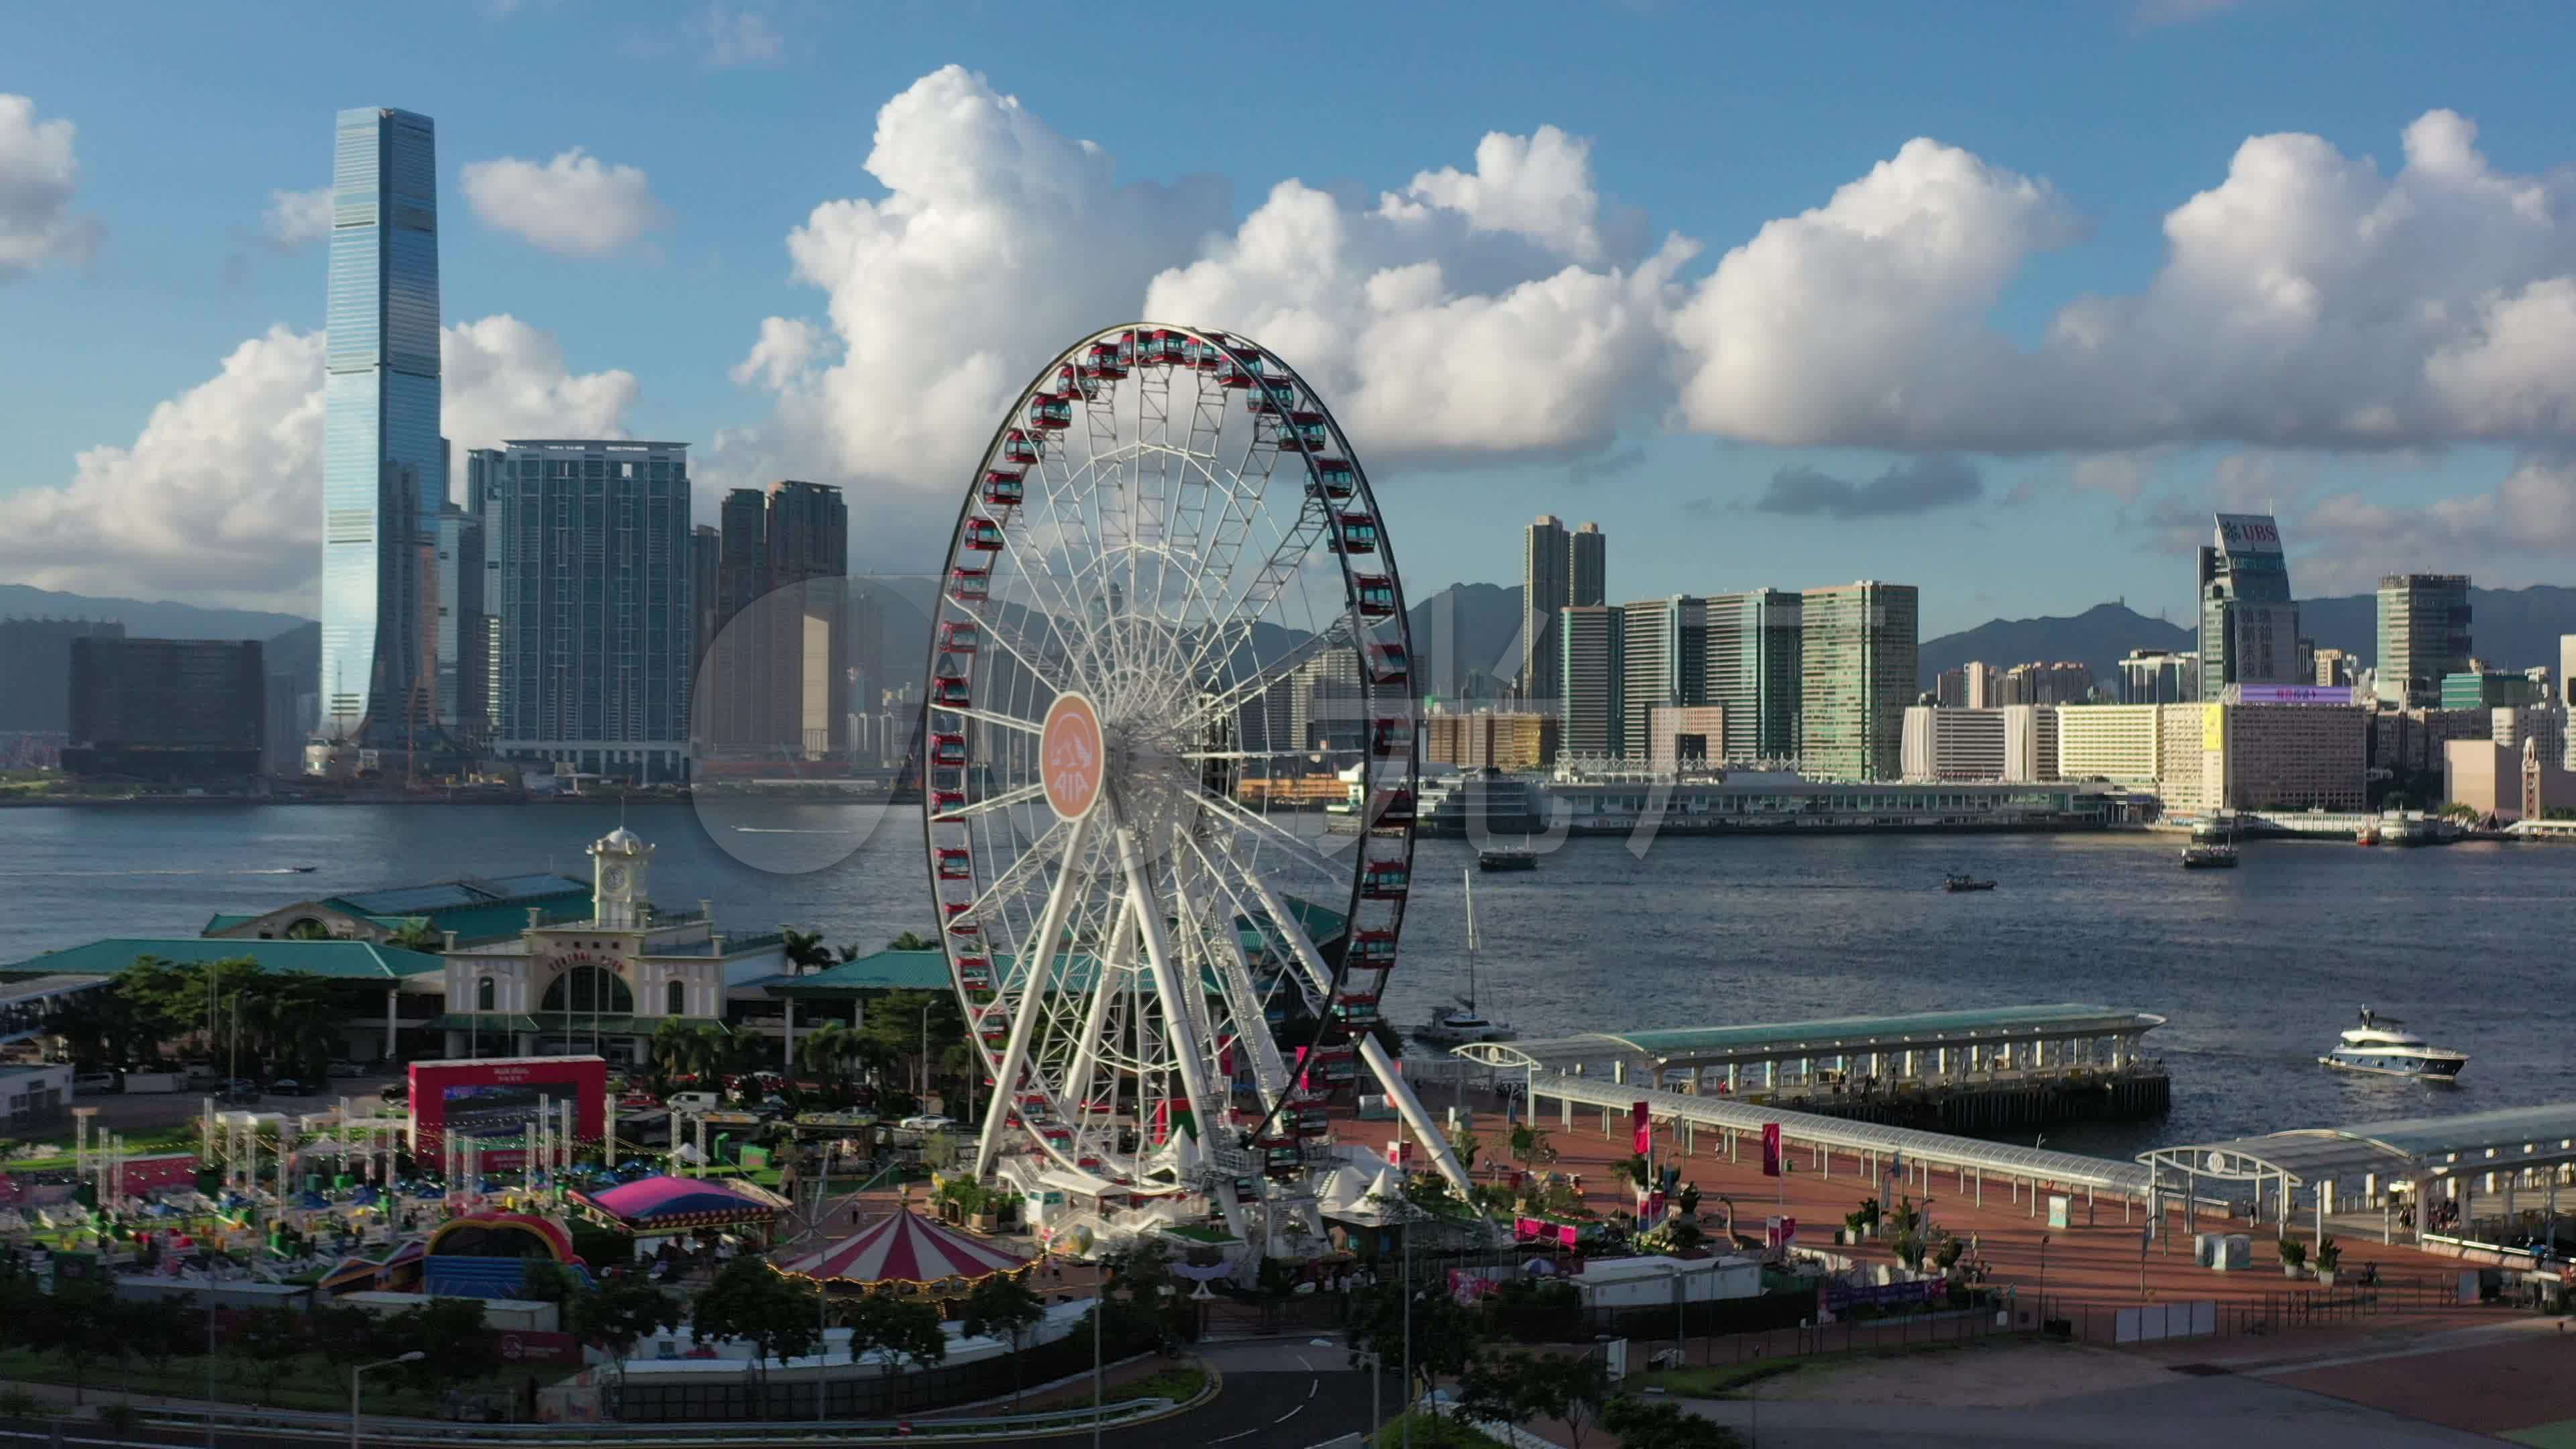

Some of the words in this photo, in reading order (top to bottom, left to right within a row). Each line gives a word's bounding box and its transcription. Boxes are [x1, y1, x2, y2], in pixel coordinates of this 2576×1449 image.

[2243, 525, 2276, 542] UBS
[1053, 771, 1090, 803] AIA
[2212, 1157, 2222, 1169] 10
